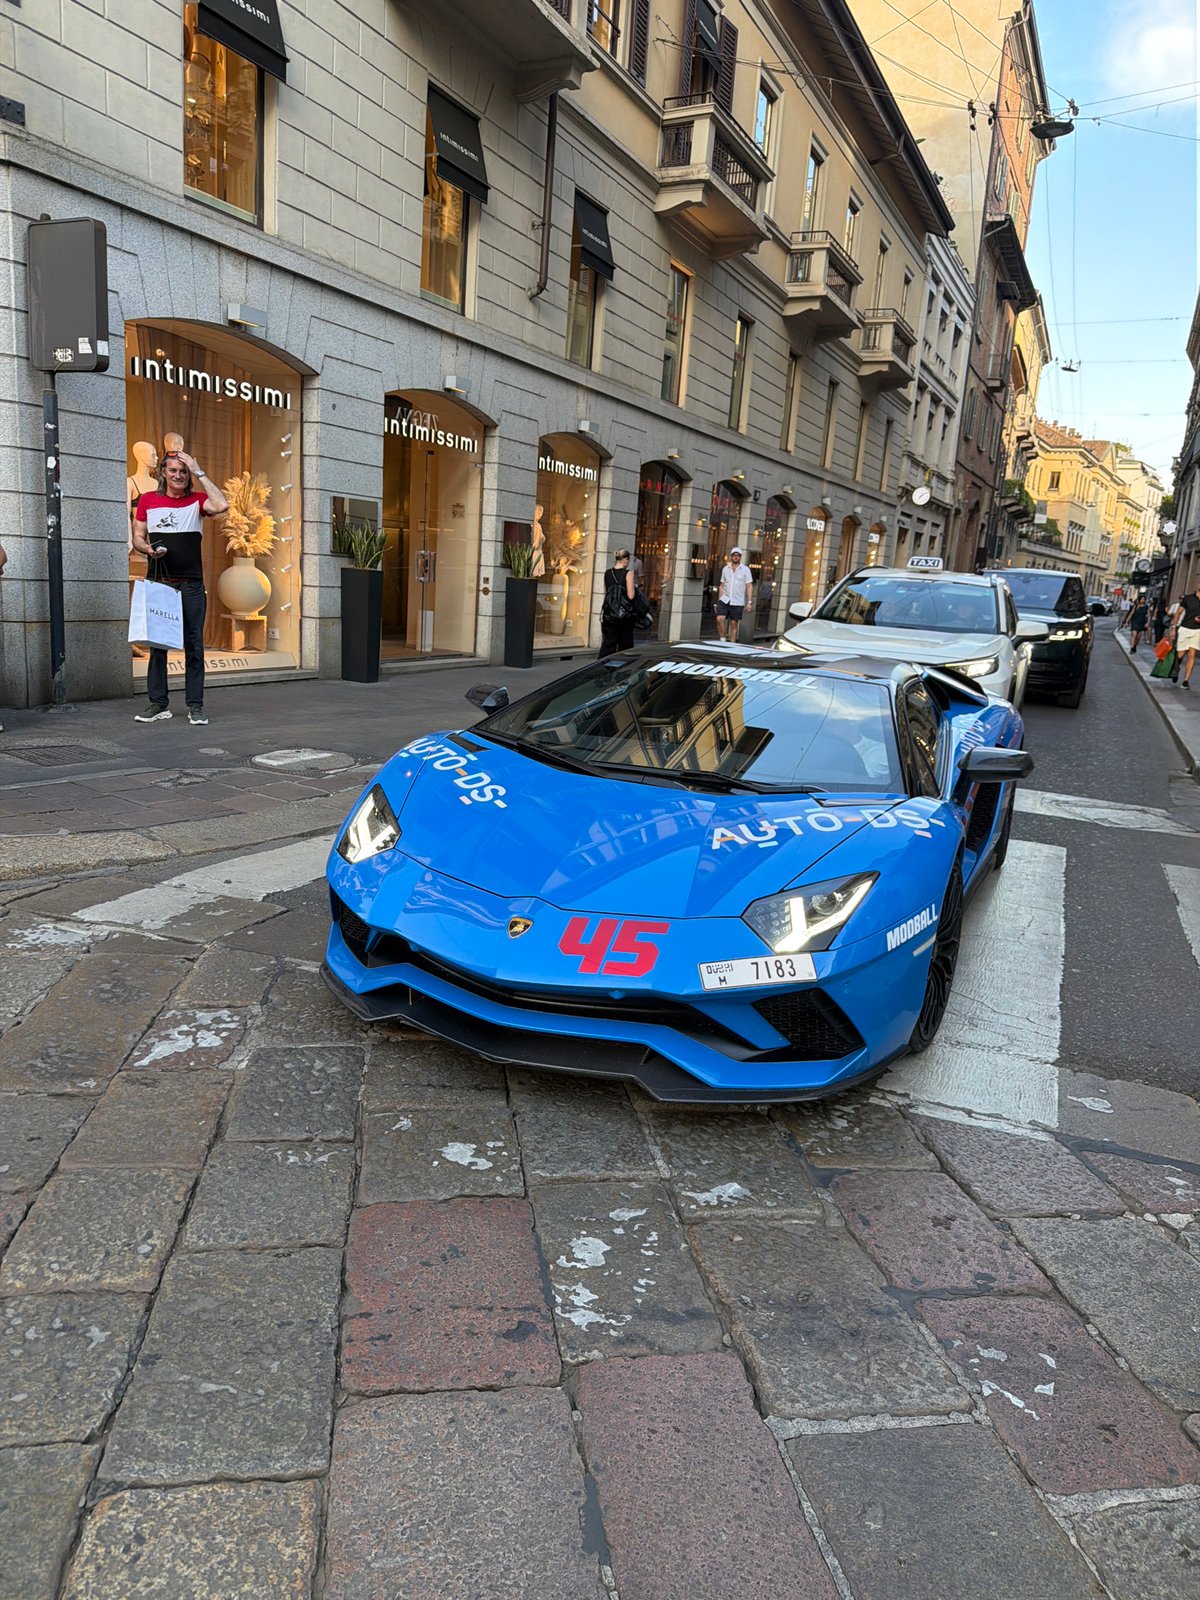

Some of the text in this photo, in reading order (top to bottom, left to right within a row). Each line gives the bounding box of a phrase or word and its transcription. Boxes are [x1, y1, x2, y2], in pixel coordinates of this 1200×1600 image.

[132, 356, 291, 410] intimissimi
[384, 417, 478, 453] intimissimi
[539, 455, 597, 482] ntimissimi
[912, 559, 939, 567] TAXI
[149, 608, 179, 621] MARELLA
[647, 661, 818, 690] MODBALL
[711, 807, 946, 850] AUTO-DS
[886, 903, 938, 952] MODBALL
[558, 916, 671, 977] 45
[718, 976, 727, 986] M
[750, 958, 797, 980] 7183
